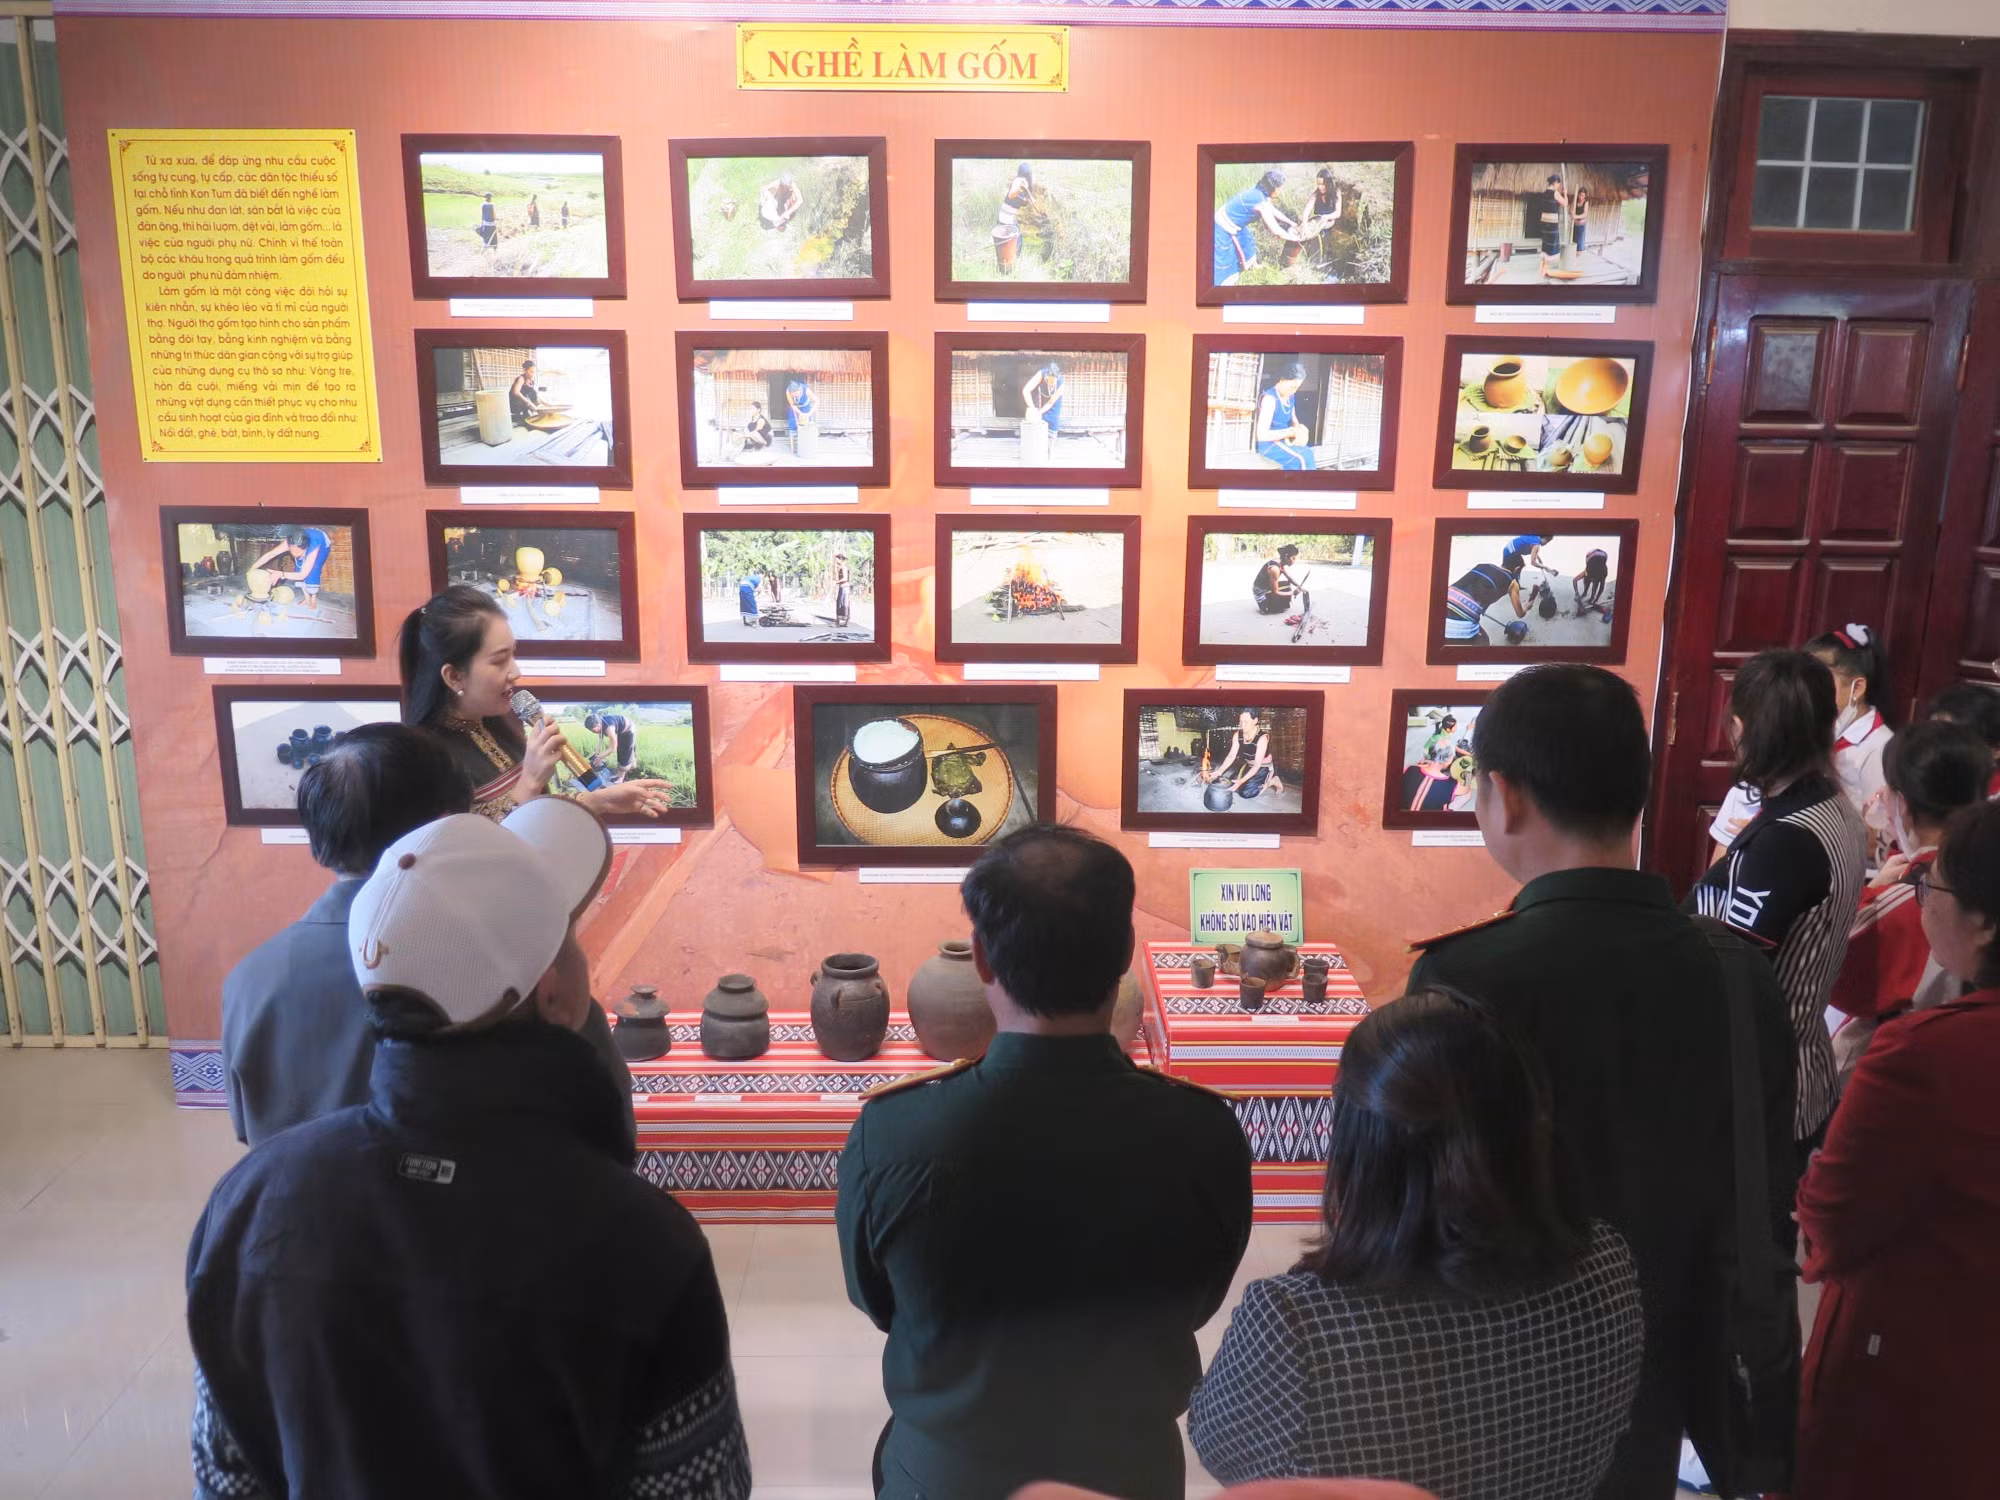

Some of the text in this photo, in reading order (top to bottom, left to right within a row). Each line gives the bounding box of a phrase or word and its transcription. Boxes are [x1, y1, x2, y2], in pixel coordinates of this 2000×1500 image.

[767, 37, 1039, 80] NGHỀ LÀM GỐM
[1221, 883, 1234, 901] XIN
[1236, 884, 1249, 901] VUI
[1200, 910, 1227, 931] KHÔNG
[1279, 910, 1293, 935] VẬT
